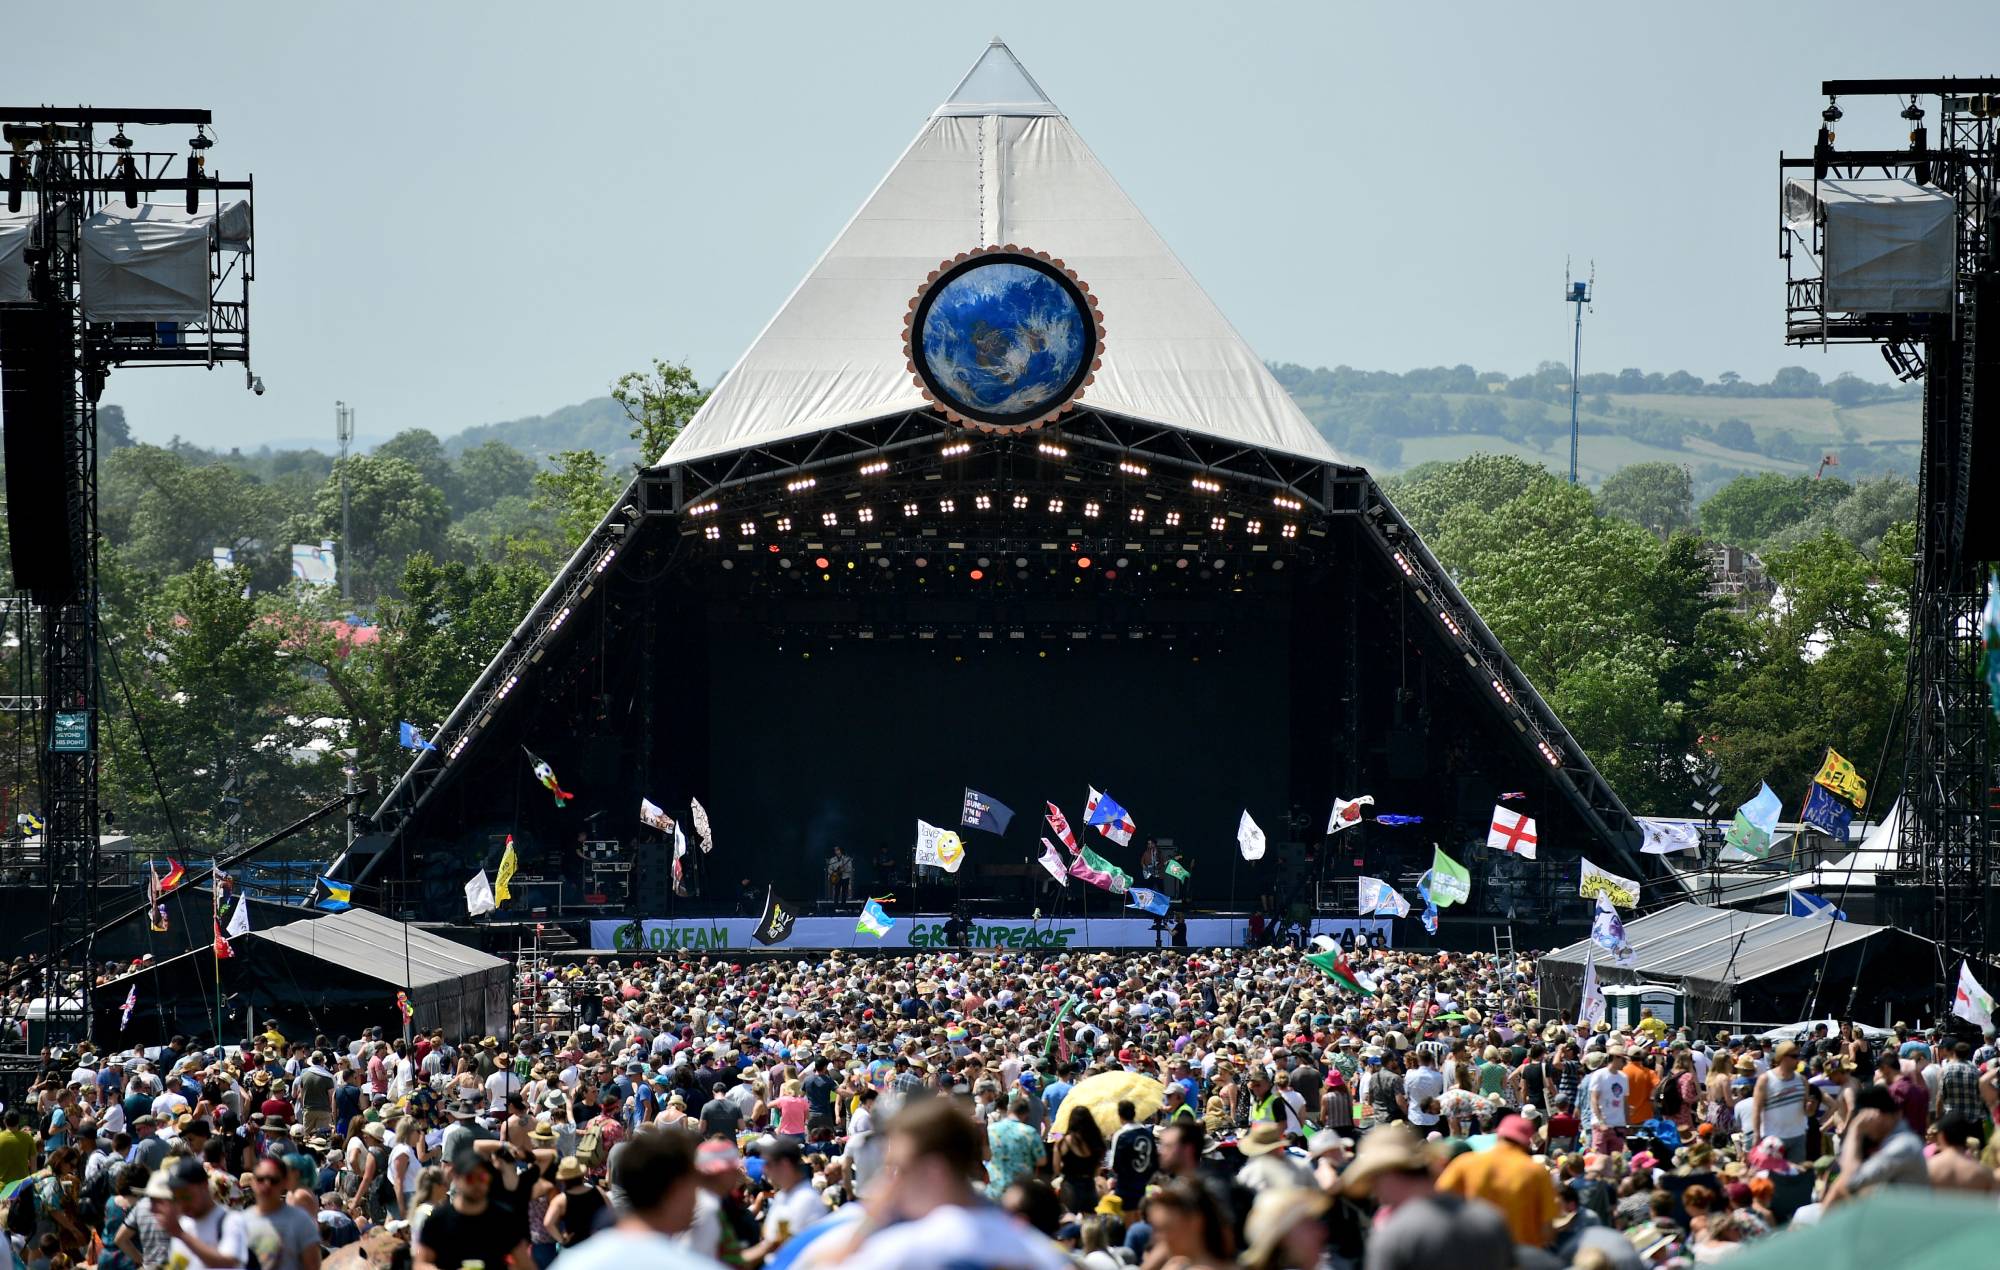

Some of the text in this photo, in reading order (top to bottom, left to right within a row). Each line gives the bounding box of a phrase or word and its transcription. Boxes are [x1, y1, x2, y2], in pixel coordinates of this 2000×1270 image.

[966, 800, 990, 812] SUNDAY
[963, 815, 980, 825] LOVE
[1603, 879, 1622, 891] are
[650, 927, 729, 950] OXFAM
[907, 923, 1076, 948] GRENPEACE
[1132, 1135, 1152, 1173] 3
